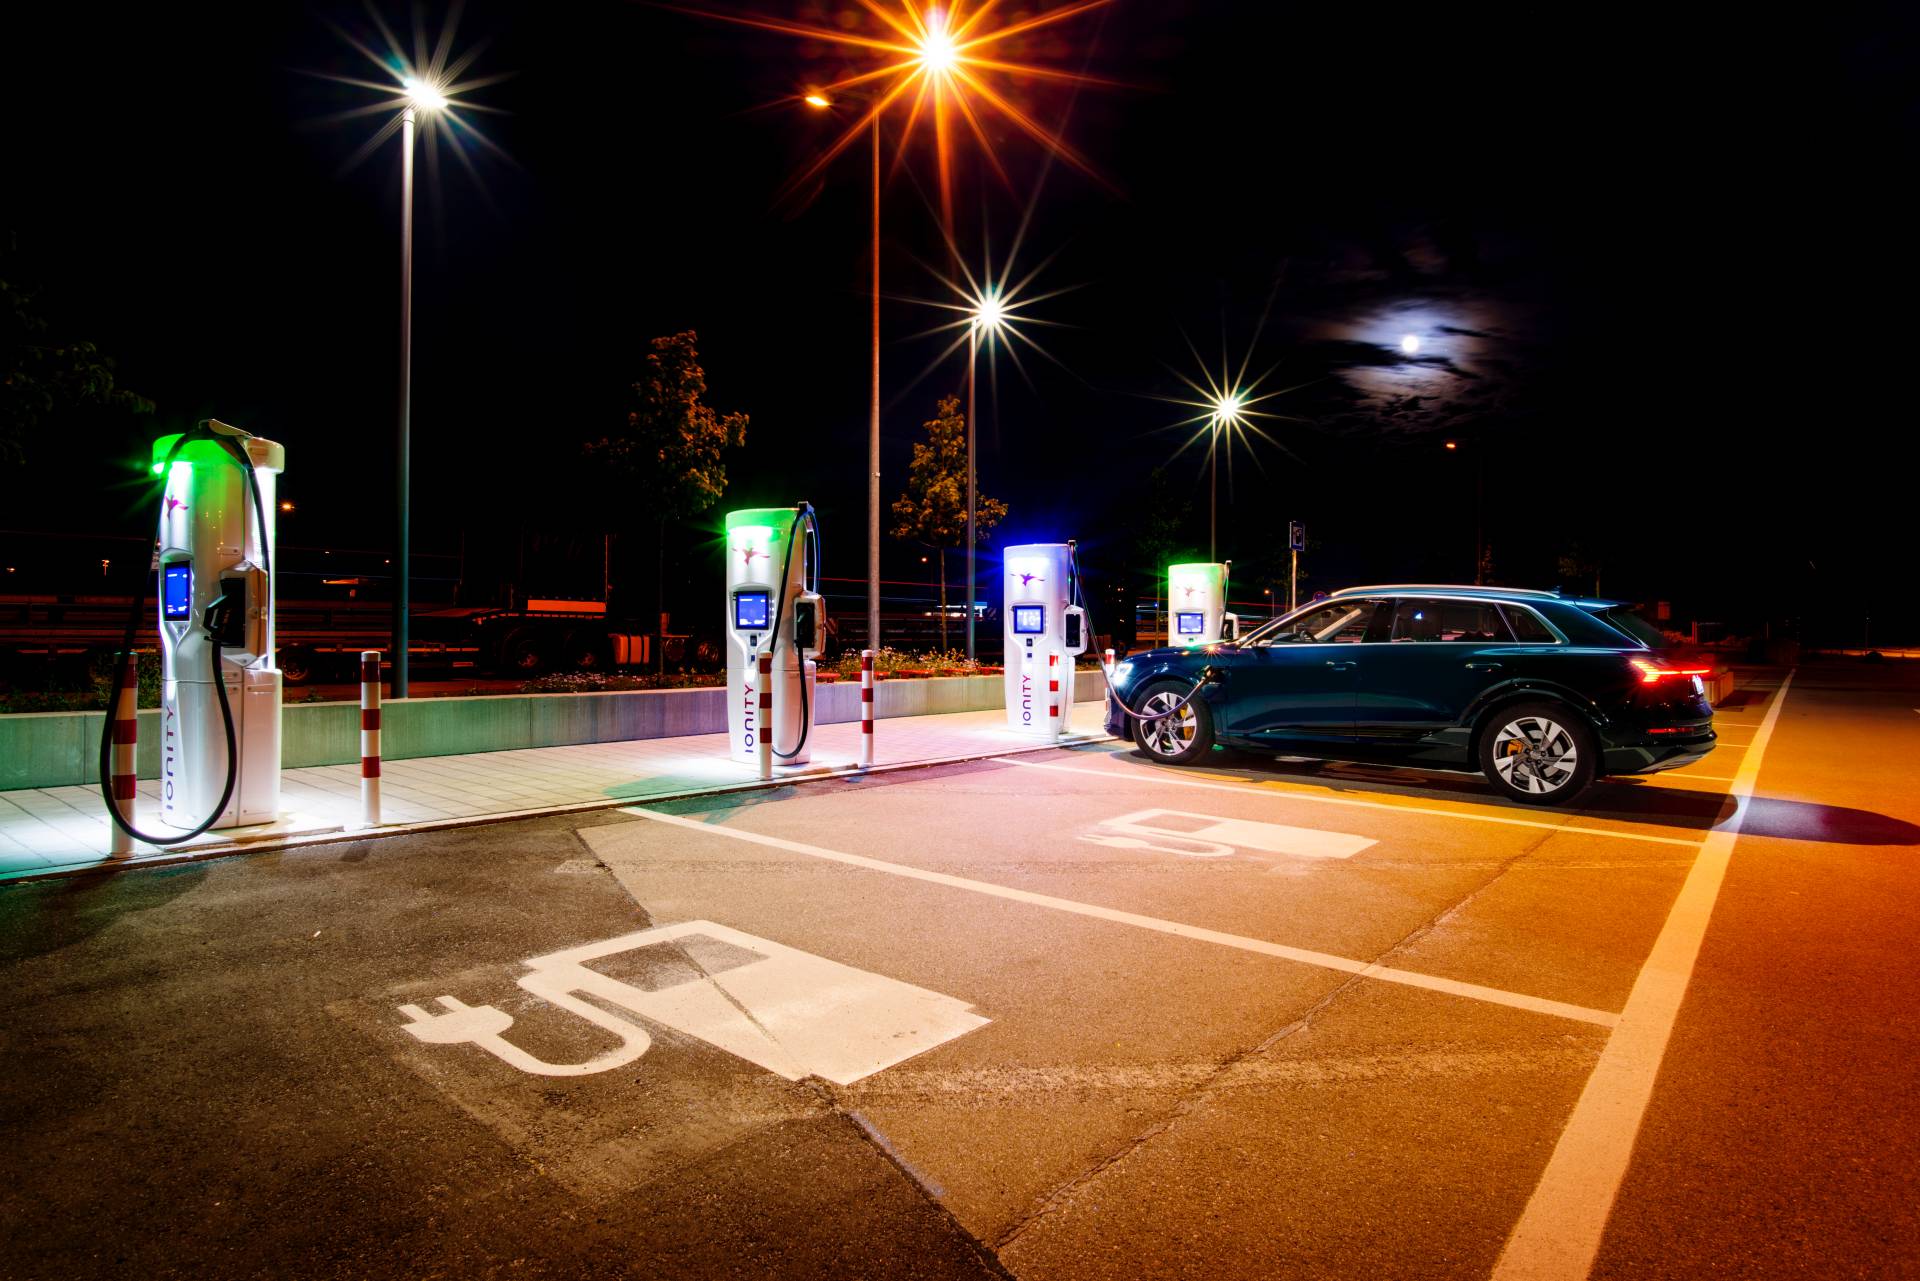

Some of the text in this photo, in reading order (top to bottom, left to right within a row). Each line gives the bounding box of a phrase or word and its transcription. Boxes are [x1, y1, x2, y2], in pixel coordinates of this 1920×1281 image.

[745, 684, 754, 753] IONITY
[1023, 675, 1031, 726] IONITY
[166, 706, 174, 810] IONITY
